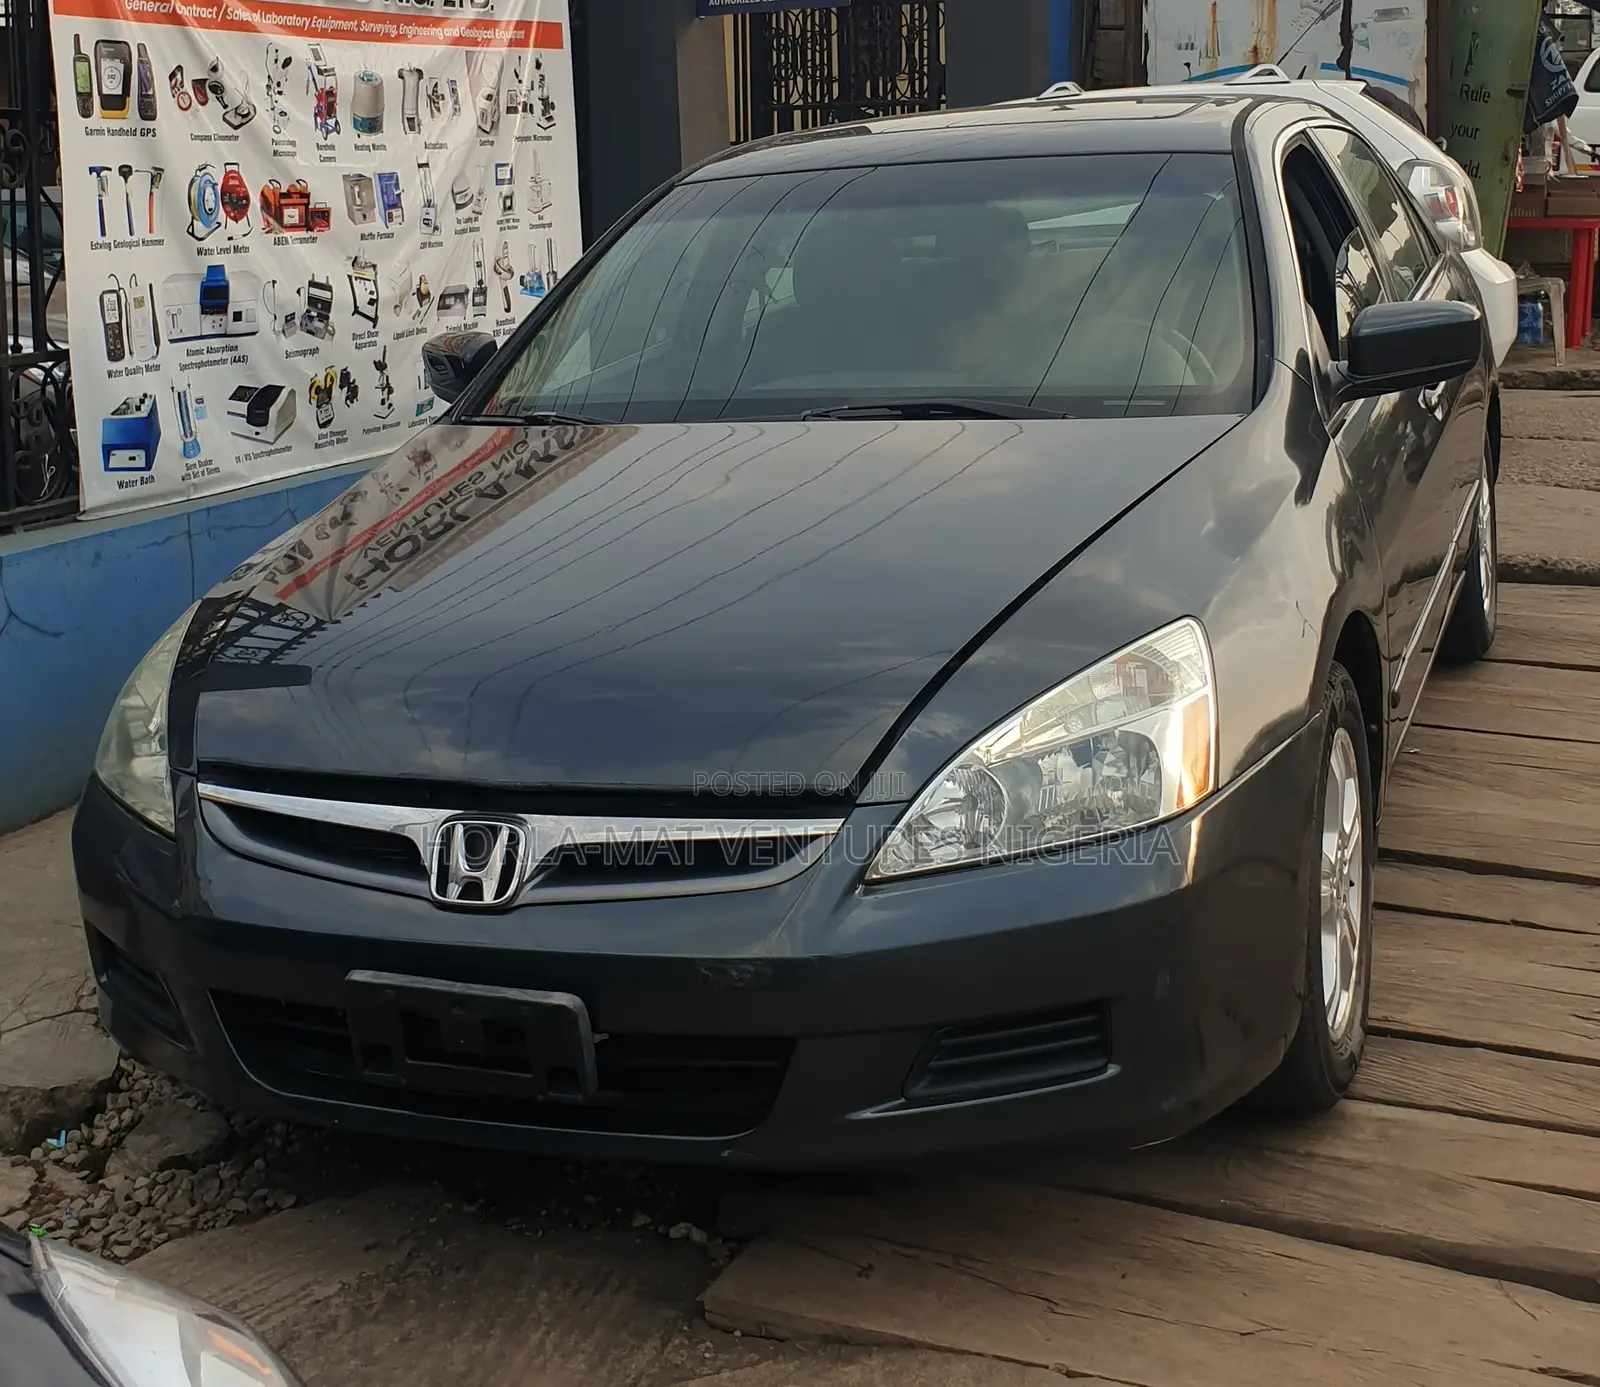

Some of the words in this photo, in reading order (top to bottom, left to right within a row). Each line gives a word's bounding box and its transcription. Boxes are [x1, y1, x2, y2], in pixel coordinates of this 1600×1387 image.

[125, 0, 173, 13] General
[175, 3, 217, 18] Contract
[226, 8, 252, 21] Sales
[252, 10, 261, 23] of
[262, 10, 311, 31] Laboratory
[311, 16, 359, 32] Equipment,
[360, 20, 398, 37] Surveying,
[399, 23, 443, 39] Engineering
[444, 26, 460, 37] and
[460, 27, 494, 41] Geological
[1459, 83, 1491, 103] Rule
[85, 126, 105, 137] Garmin
[107, 126, 137, 137] Handheld
[140, 128, 157, 138] GPS
[190, 133, 213, 142] Compass
[1450, 123, 1480, 140] your
[1461, 160, 1482, 179] rld.
[91, 240, 112, 251] Estwing
[113, 240, 140, 250] Geological
[142, 237, 165, 247] Hammer
[197, 246, 216, 256] Water
[216, 245, 232, 255] Level
[232, 244, 250, 254] Meter
[186, 347, 205, 358] Atomic
[206, 344, 239, 356] Absorption
[285, 347, 320, 360] Seismograph
[230, 355, 249, 366] (AAS)
[107, 369, 124, 380] Water
[125, 367, 144, 378] Quality
[144, 364, 161, 375] Meter
[117, 478, 138, 490] Water
[140, 475, 155, 487] Bath
